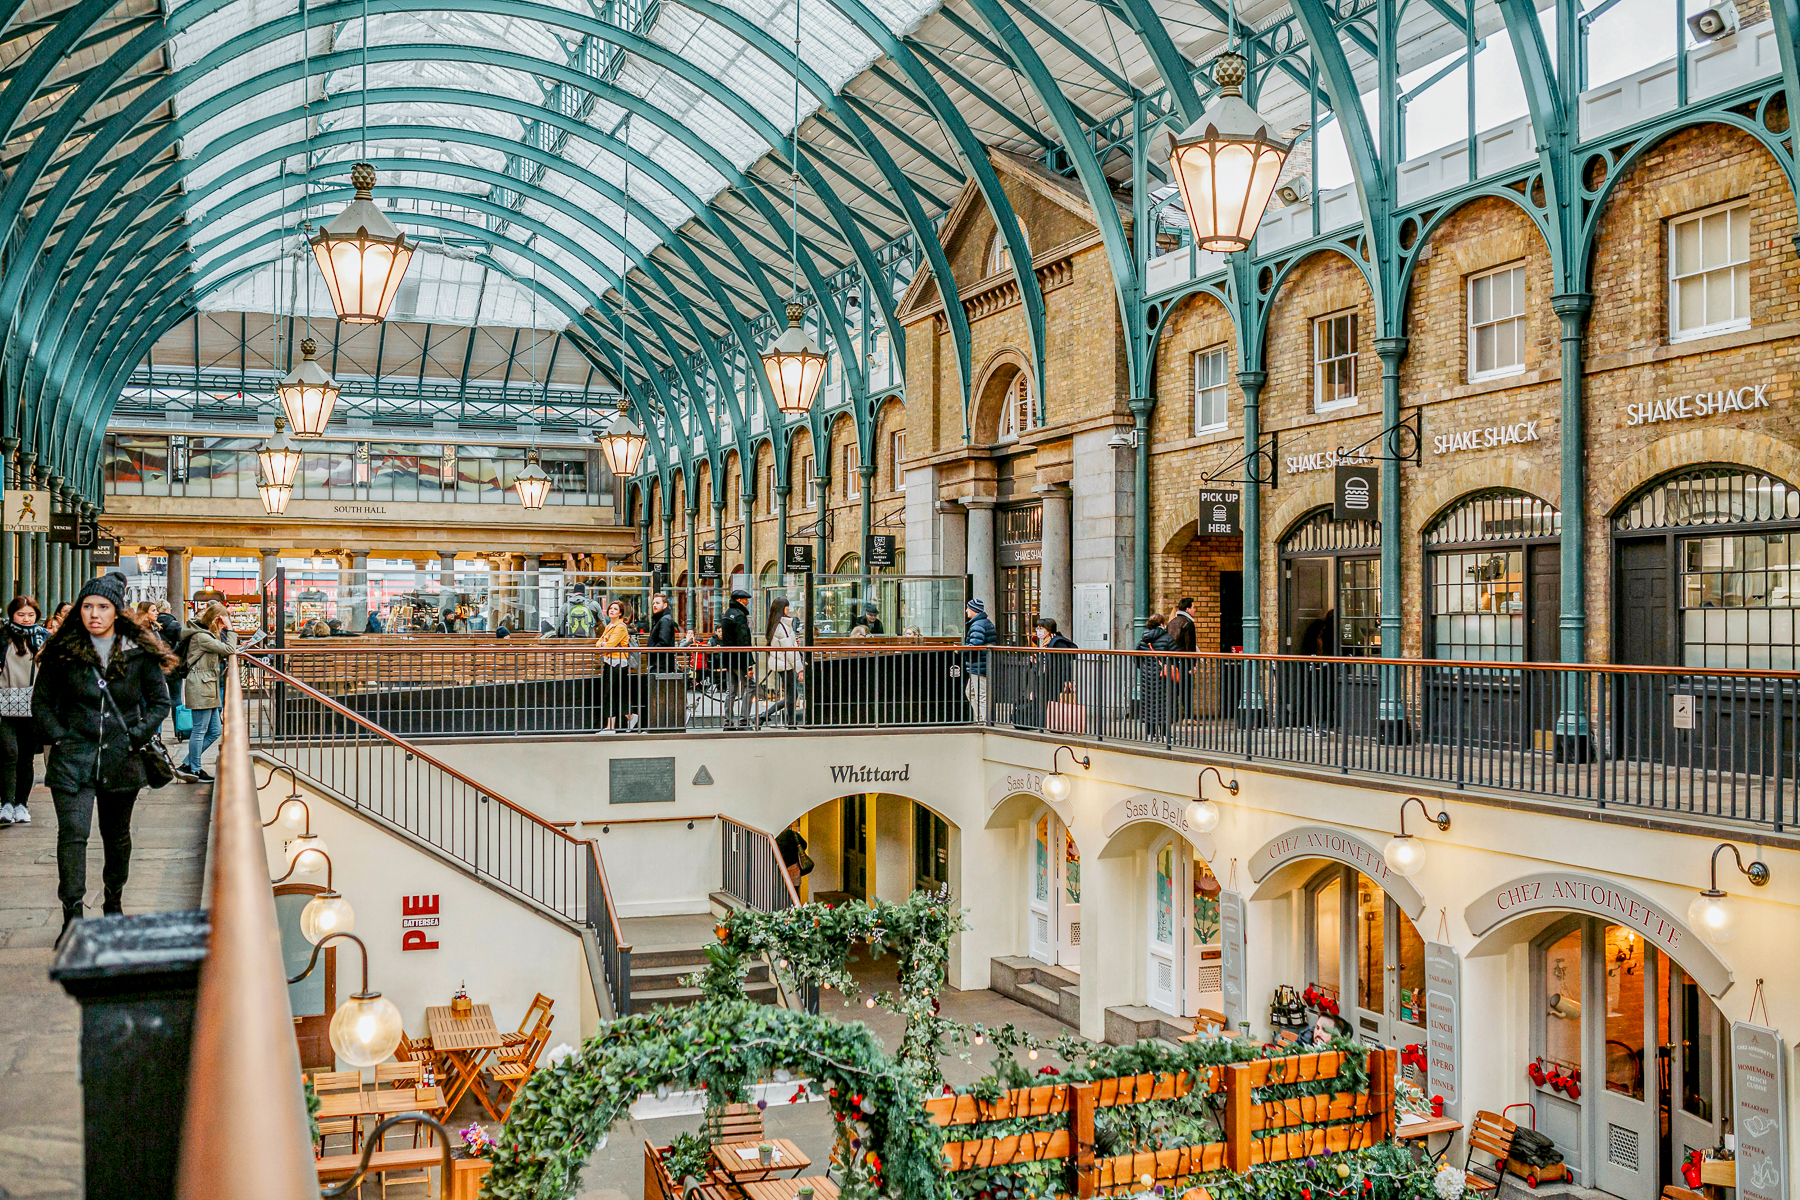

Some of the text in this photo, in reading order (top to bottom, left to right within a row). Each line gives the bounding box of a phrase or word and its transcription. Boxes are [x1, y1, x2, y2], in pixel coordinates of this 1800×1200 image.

[1626, 383, 1769, 426] SHAKE SHACK
[1433, 420, 1539, 455] SHAKE SHACK
[1286, 453, 1325, 474] SHAKE
[1201, 492, 1239, 503] PICK UP
[333, 505, 386, 514] SOUTH HALL
[1208, 523, 1231, 533] HERE
[1014, 550, 1042, 561] SHAKE SHAC
[829, 763, 910, 783] Whittard
[1006, 776, 1025, 792] Sass
[1026, 774, 1032, 789] &
[1125, 798, 1189, 832] Sass & Belle
[1269, 833, 1393, 883] CHEZ ANTOINETTE
[1497, 880, 1682, 949] CHEZ ANTOINETTE
[403, 918, 439, 927] BATTERSEA
[1429, 974, 1439, 982] TAKE
[1430, 1002, 1452, 1014] BREAKFAST
[1430, 1019, 1453, 1034] LUNCH
[1431, 1039, 1454, 1053] TEATIME
[1748, 1045, 1775, 1060] ANTOINETTE
[1431, 1058, 1454, 1072] APERO
[1737, 1064, 1775, 1080] HOMEMADE
[1431, 1077, 1455, 1093] DINNER
[1746, 1074, 1767, 1086] FRENCH
[1746, 1082, 1768, 1093] CUISINE
[1741, 1101, 1769, 1114] BREAKFAST
[1741, 1143, 1761, 1153] COFFEE
[1742, 1150, 1752, 1158] TEA
